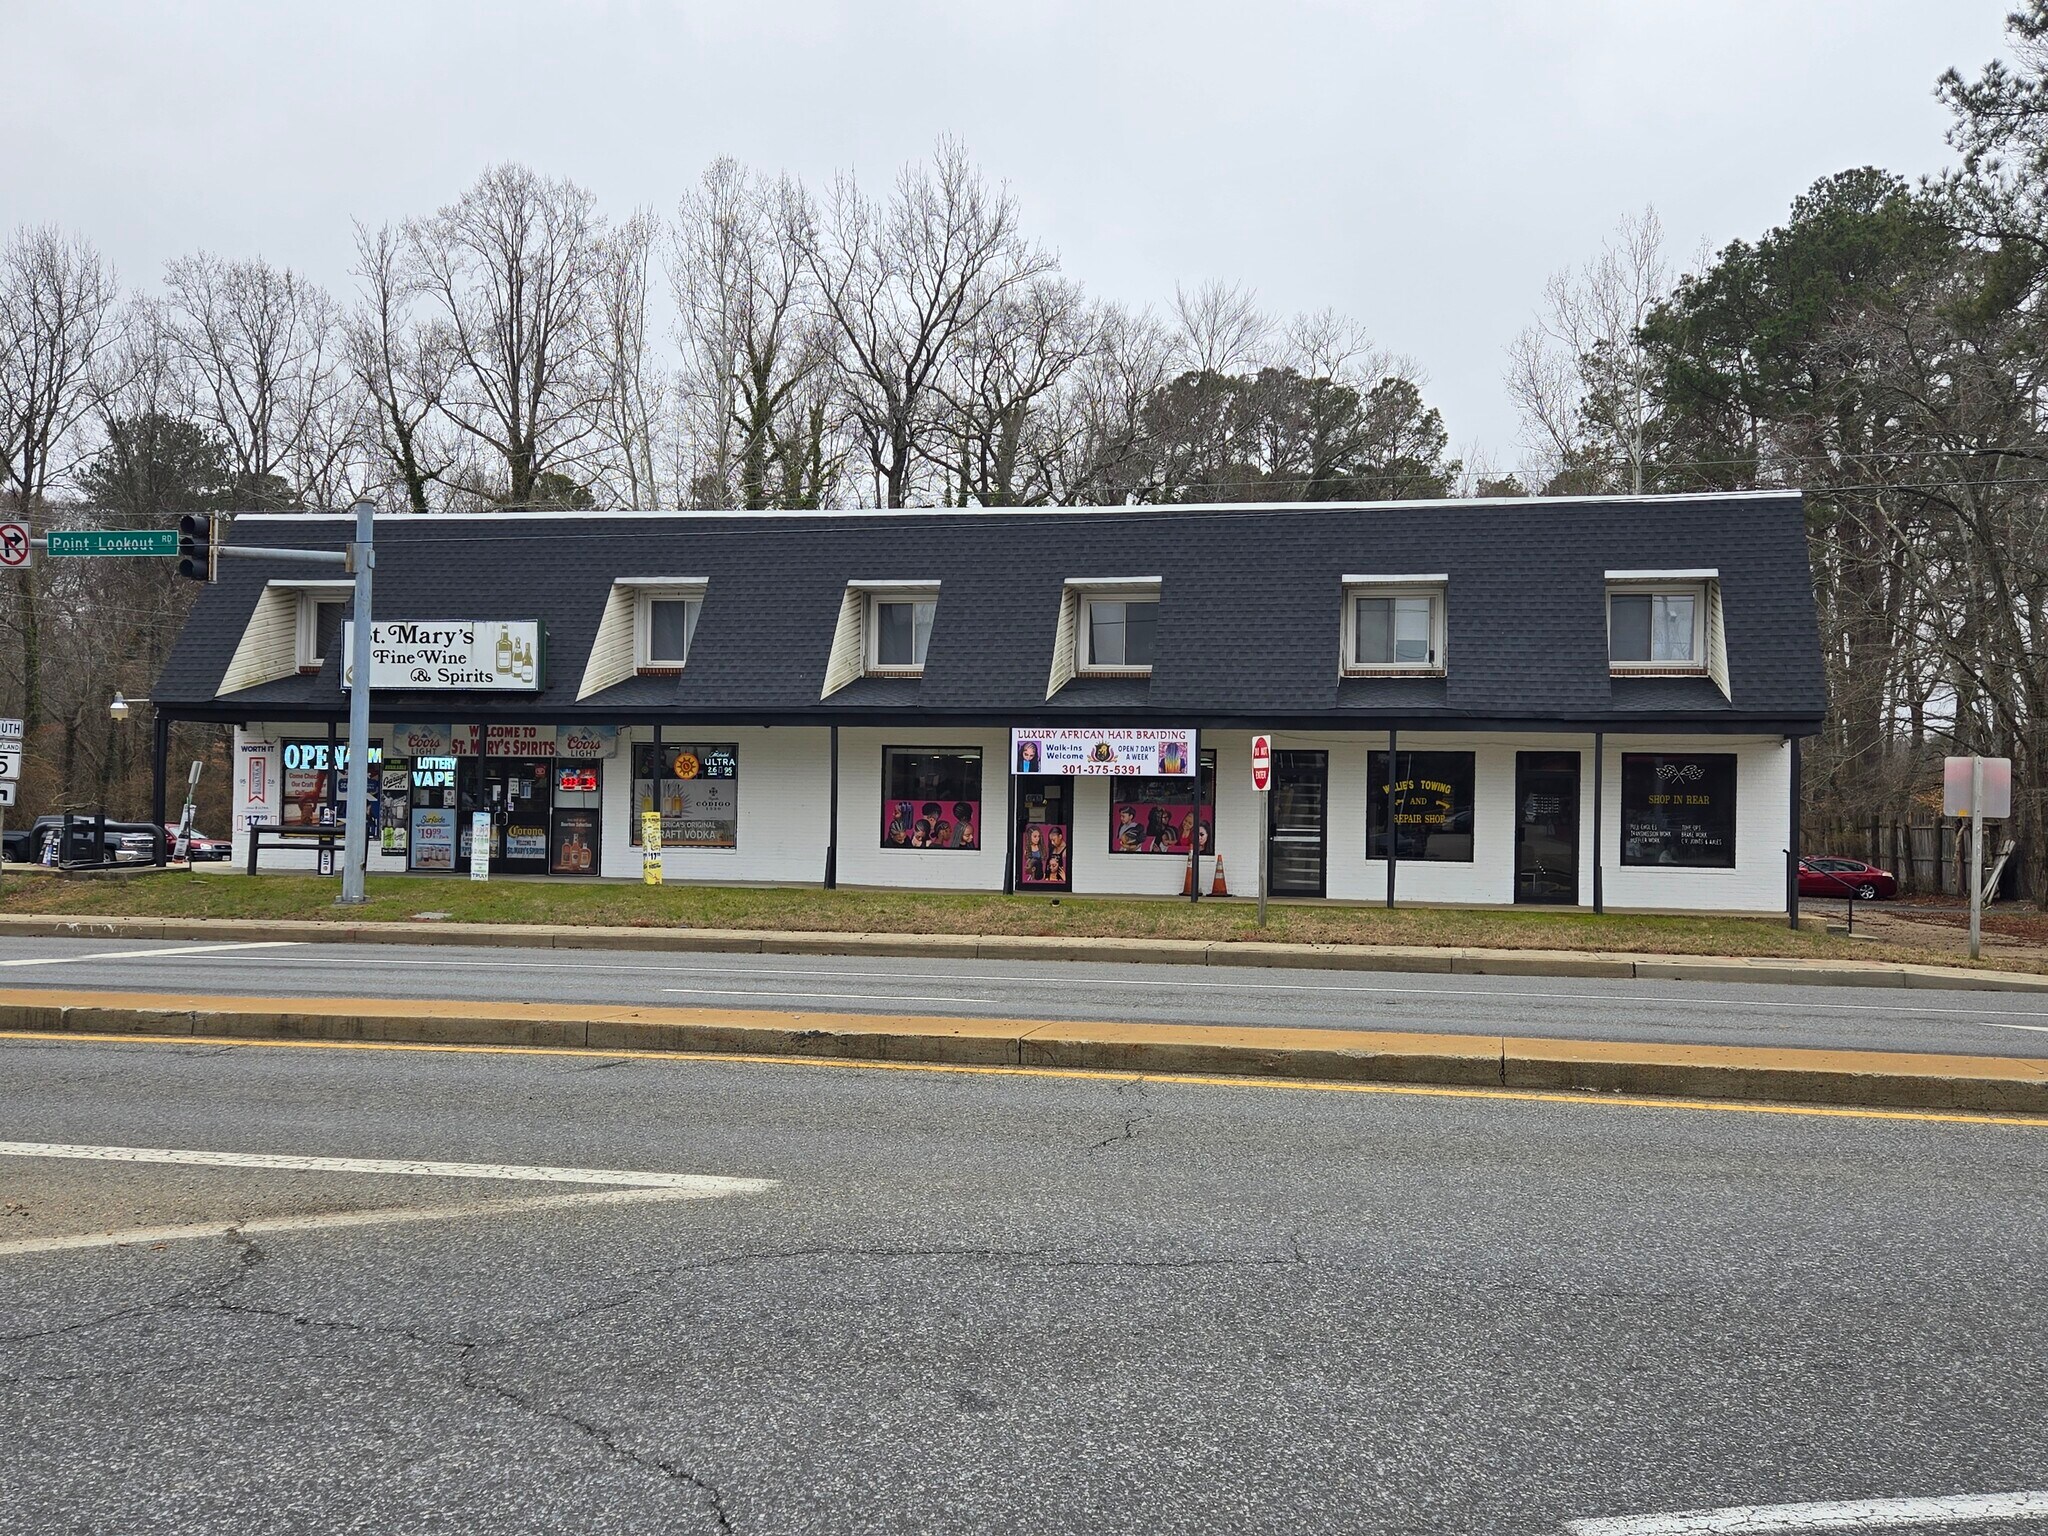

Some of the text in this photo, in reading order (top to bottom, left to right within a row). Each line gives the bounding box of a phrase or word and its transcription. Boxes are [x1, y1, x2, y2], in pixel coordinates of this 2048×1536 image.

[53, 535, 173, 551] Point Lookout RD
[388, 625, 474, 648] Mary's
[372, 650, 467, 665] Fine Wine
[410, 667, 494, 685] & Spirits
[1, 723, 20, 734] UTH
[469, 725, 536, 738] WLCOME TO
[1018, 730, 1186, 740] LUXURY AFRICAN HAIR BRAIDING
[408, 734, 440, 748] Coors
[451, 739, 555, 756] ST. MRY'S SPIRITS
[567, 735, 601, 750] Coors
[284, 744, 346, 770] OPEN
[417, 757, 457, 770] LOTTERY
[705, 758, 736, 766] ULTRA
[1062, 765, 1141, 775] 301-375-5391
[412, 771, 455, 787] VAPE
[1421, 780, 1451, 794] TOWING
[1648, 795, 1710, 804] SHOP IN REAR
[1394, 814, 1445, 824] REPAIR SHOP
[508, 825, 543, 837] Corona
[660, 830, 716, 839] RAFT VODKA
